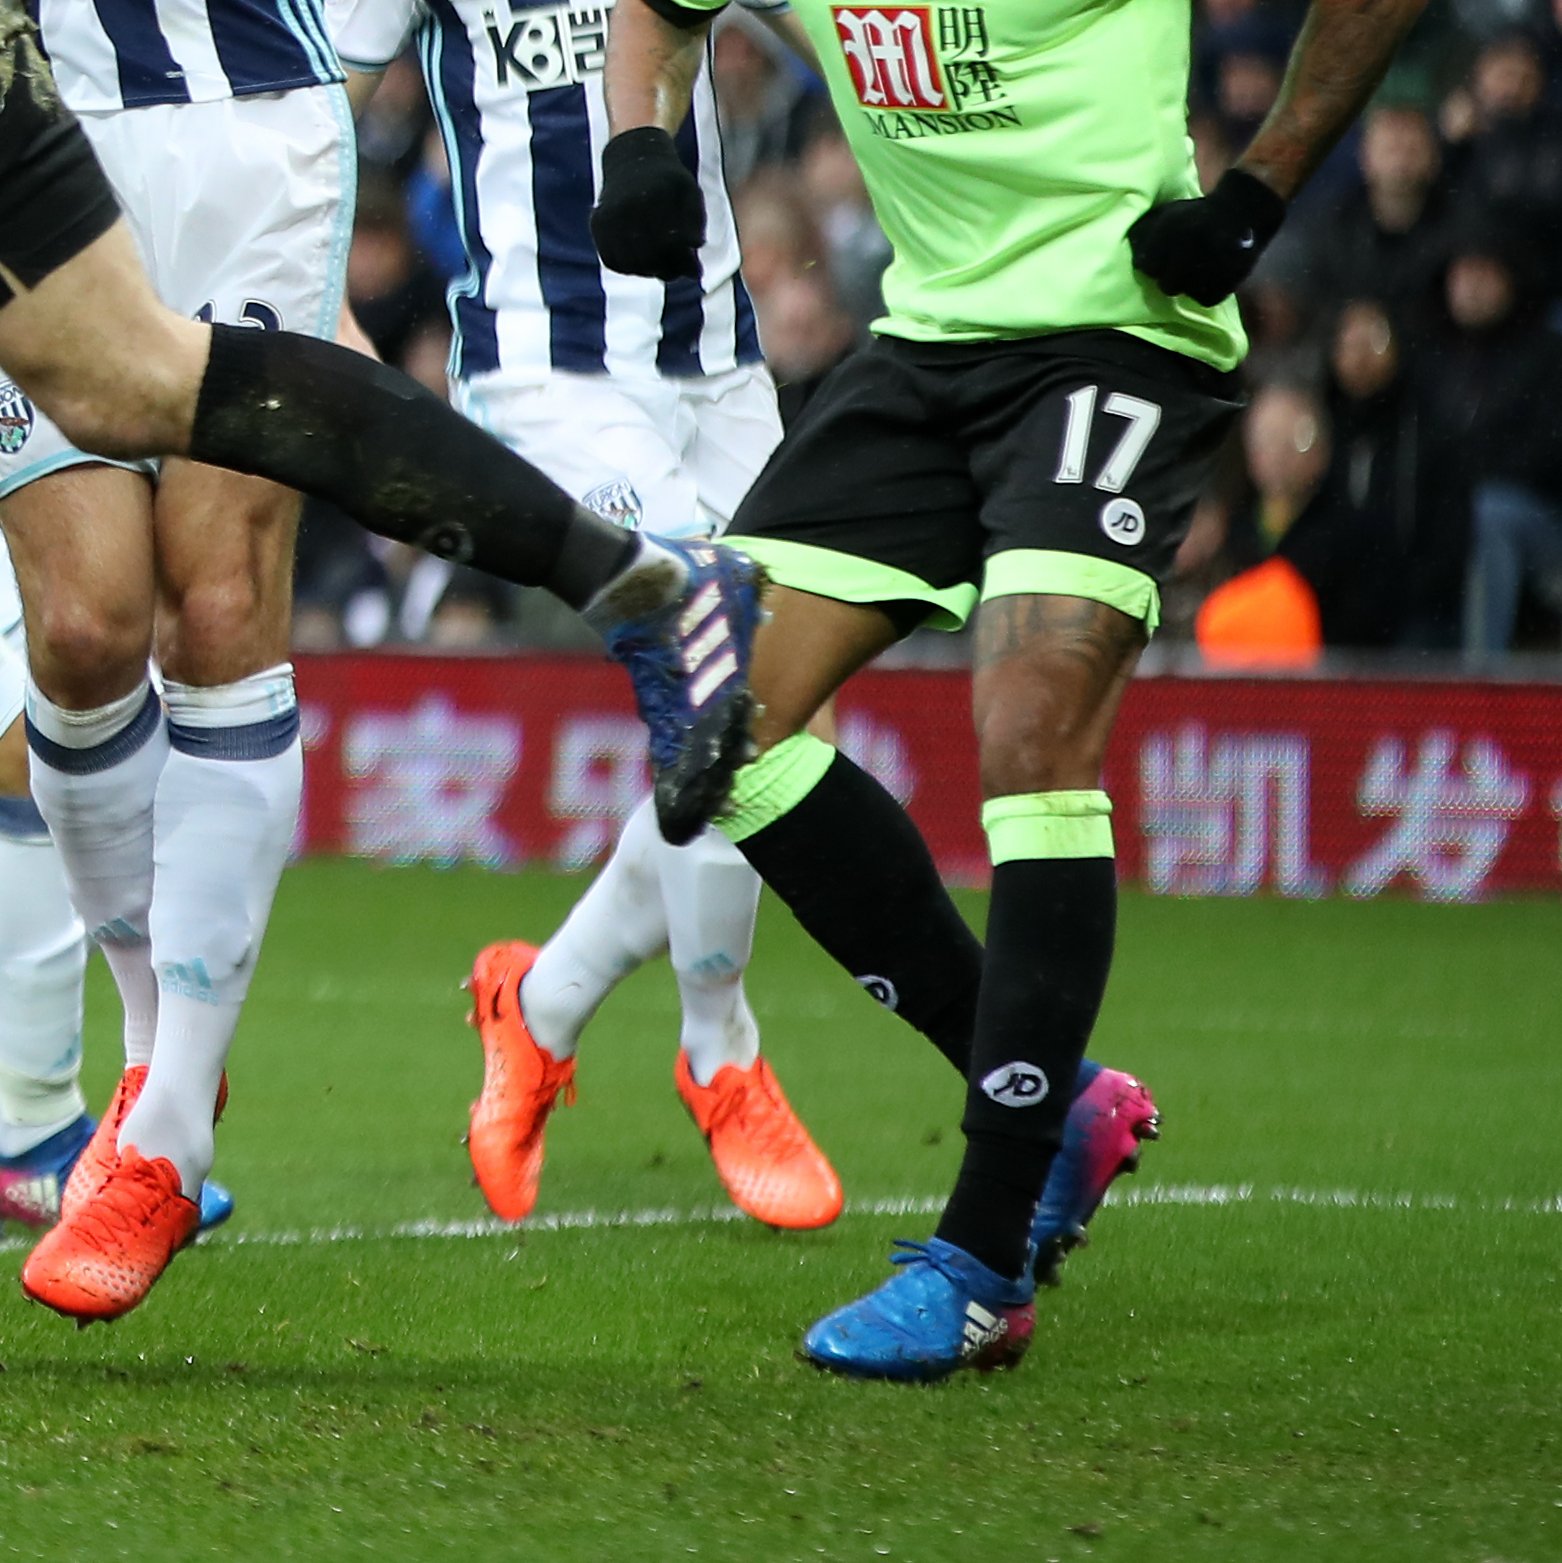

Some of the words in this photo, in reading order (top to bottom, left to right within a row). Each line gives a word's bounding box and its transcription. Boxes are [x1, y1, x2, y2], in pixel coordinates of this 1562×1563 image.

[863, 105, 1023, 140] MANSION
[1053, 385, 1162, 494] 17
[1111, 512, 1139, 533] JD
[993, 1068, 1043, 1096] JD
